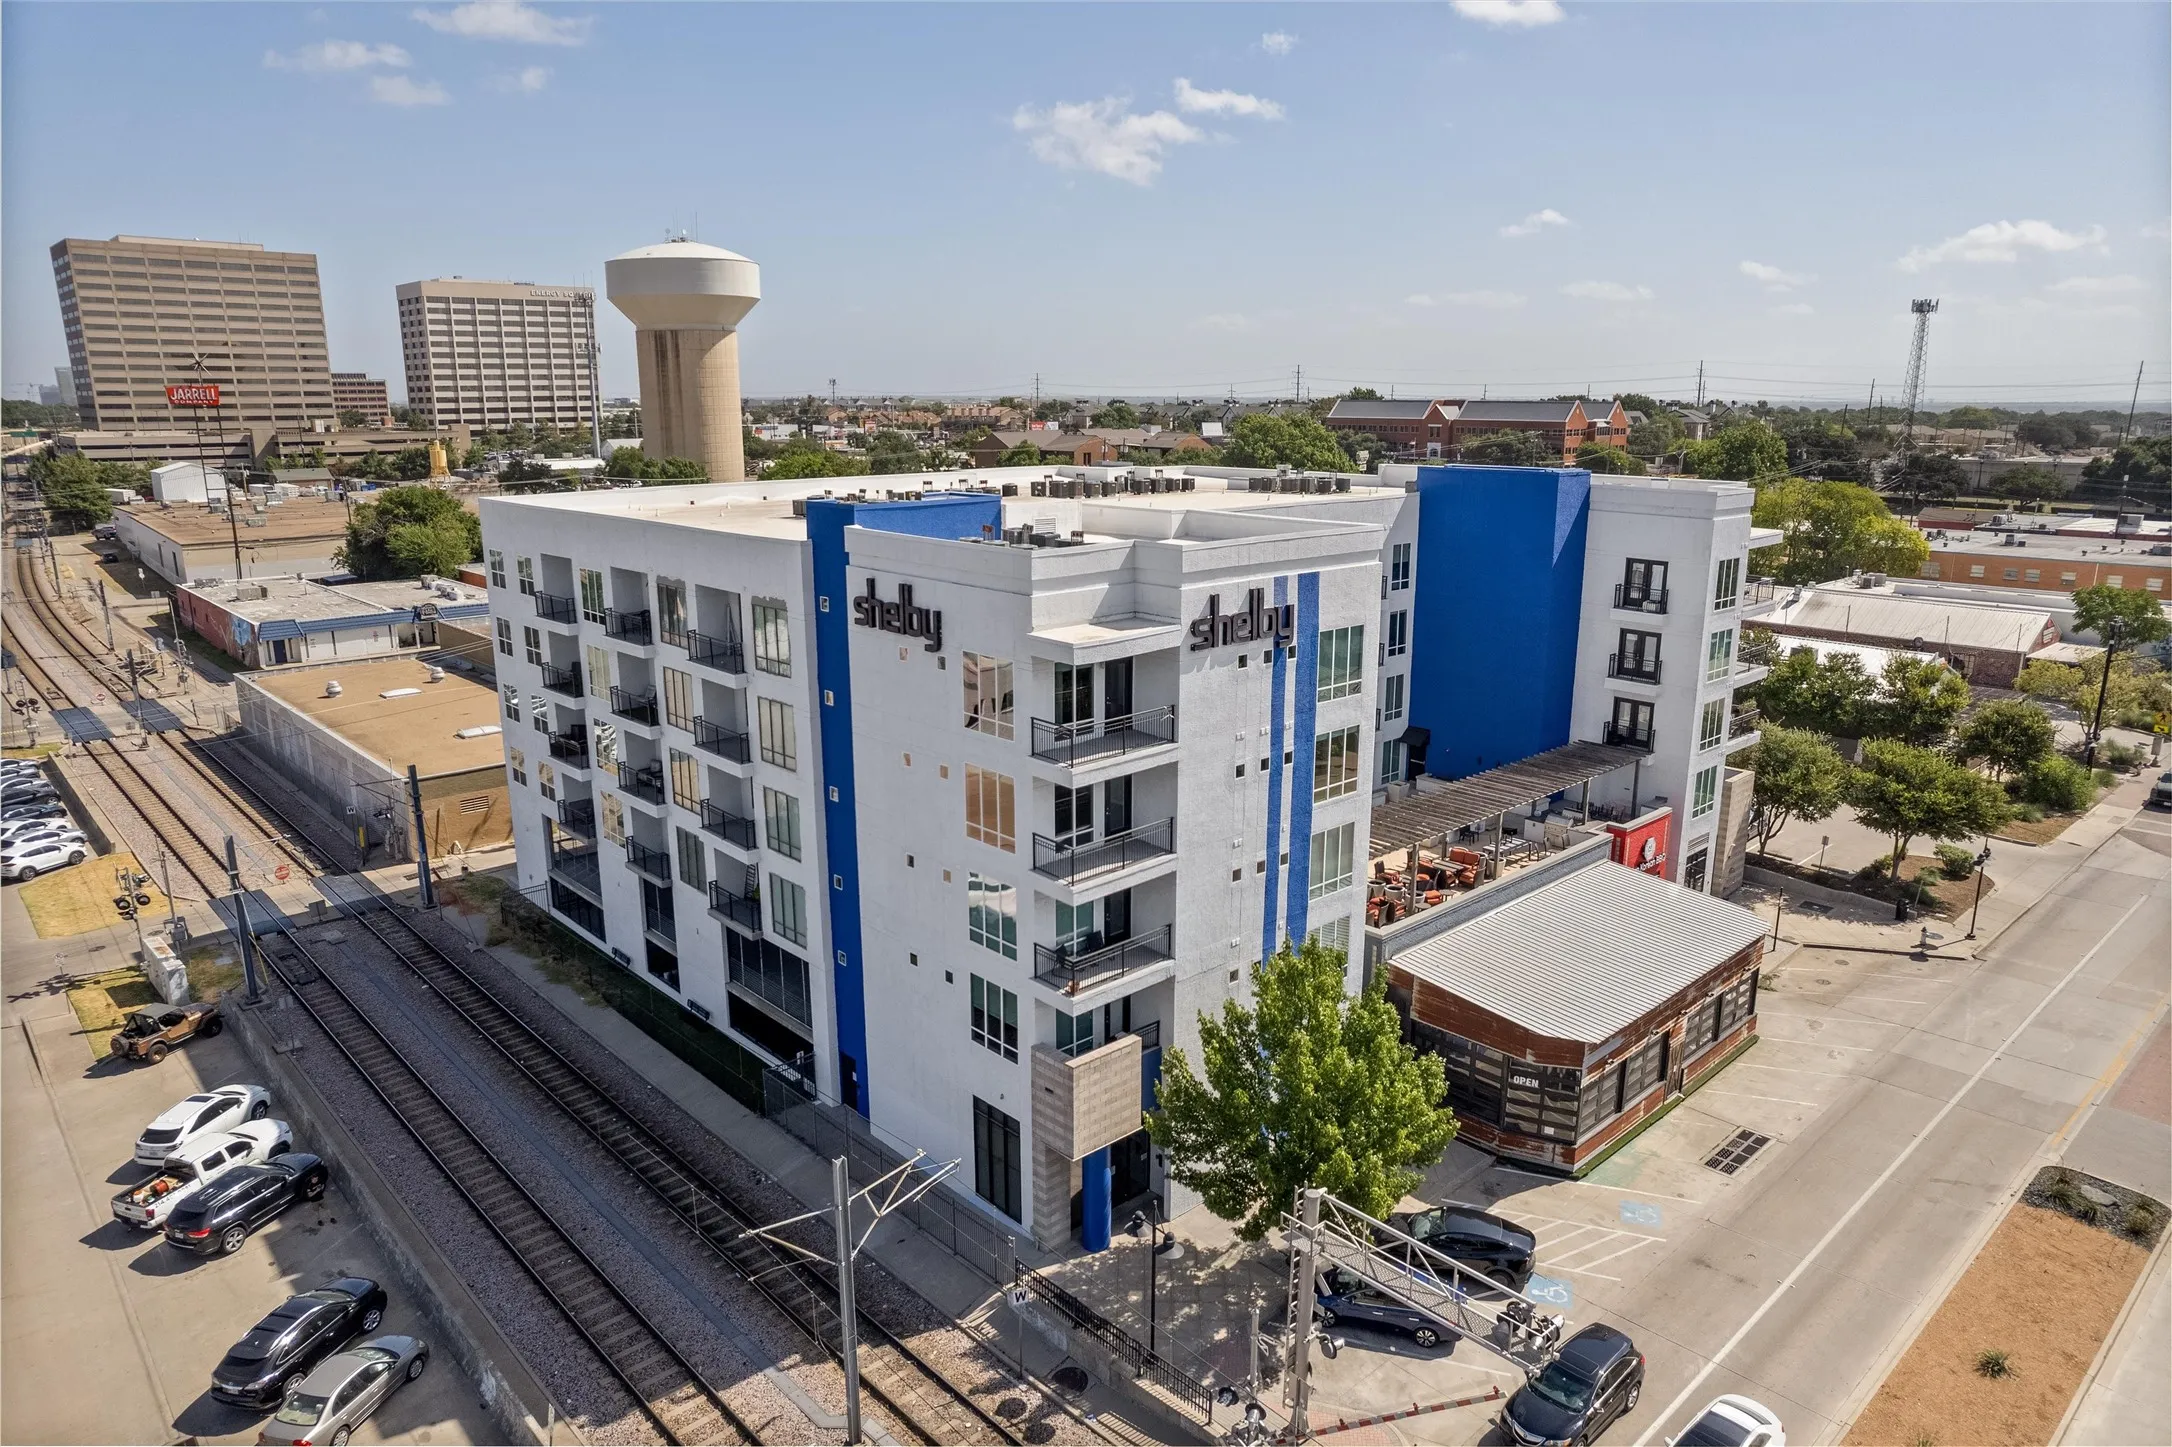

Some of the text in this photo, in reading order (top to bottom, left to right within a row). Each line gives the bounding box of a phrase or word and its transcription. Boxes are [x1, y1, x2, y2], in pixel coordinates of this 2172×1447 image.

[529, 289, 561, 298] ENERGY
[170, 388, 218, 400] JARRELL
[853, 577, 942, 653] shelby
[1190, 587, 1295, 652] shelby
[1513, 1075, 1540, 1088] OPEN
[1014, 1290, 1027, 1303] W
